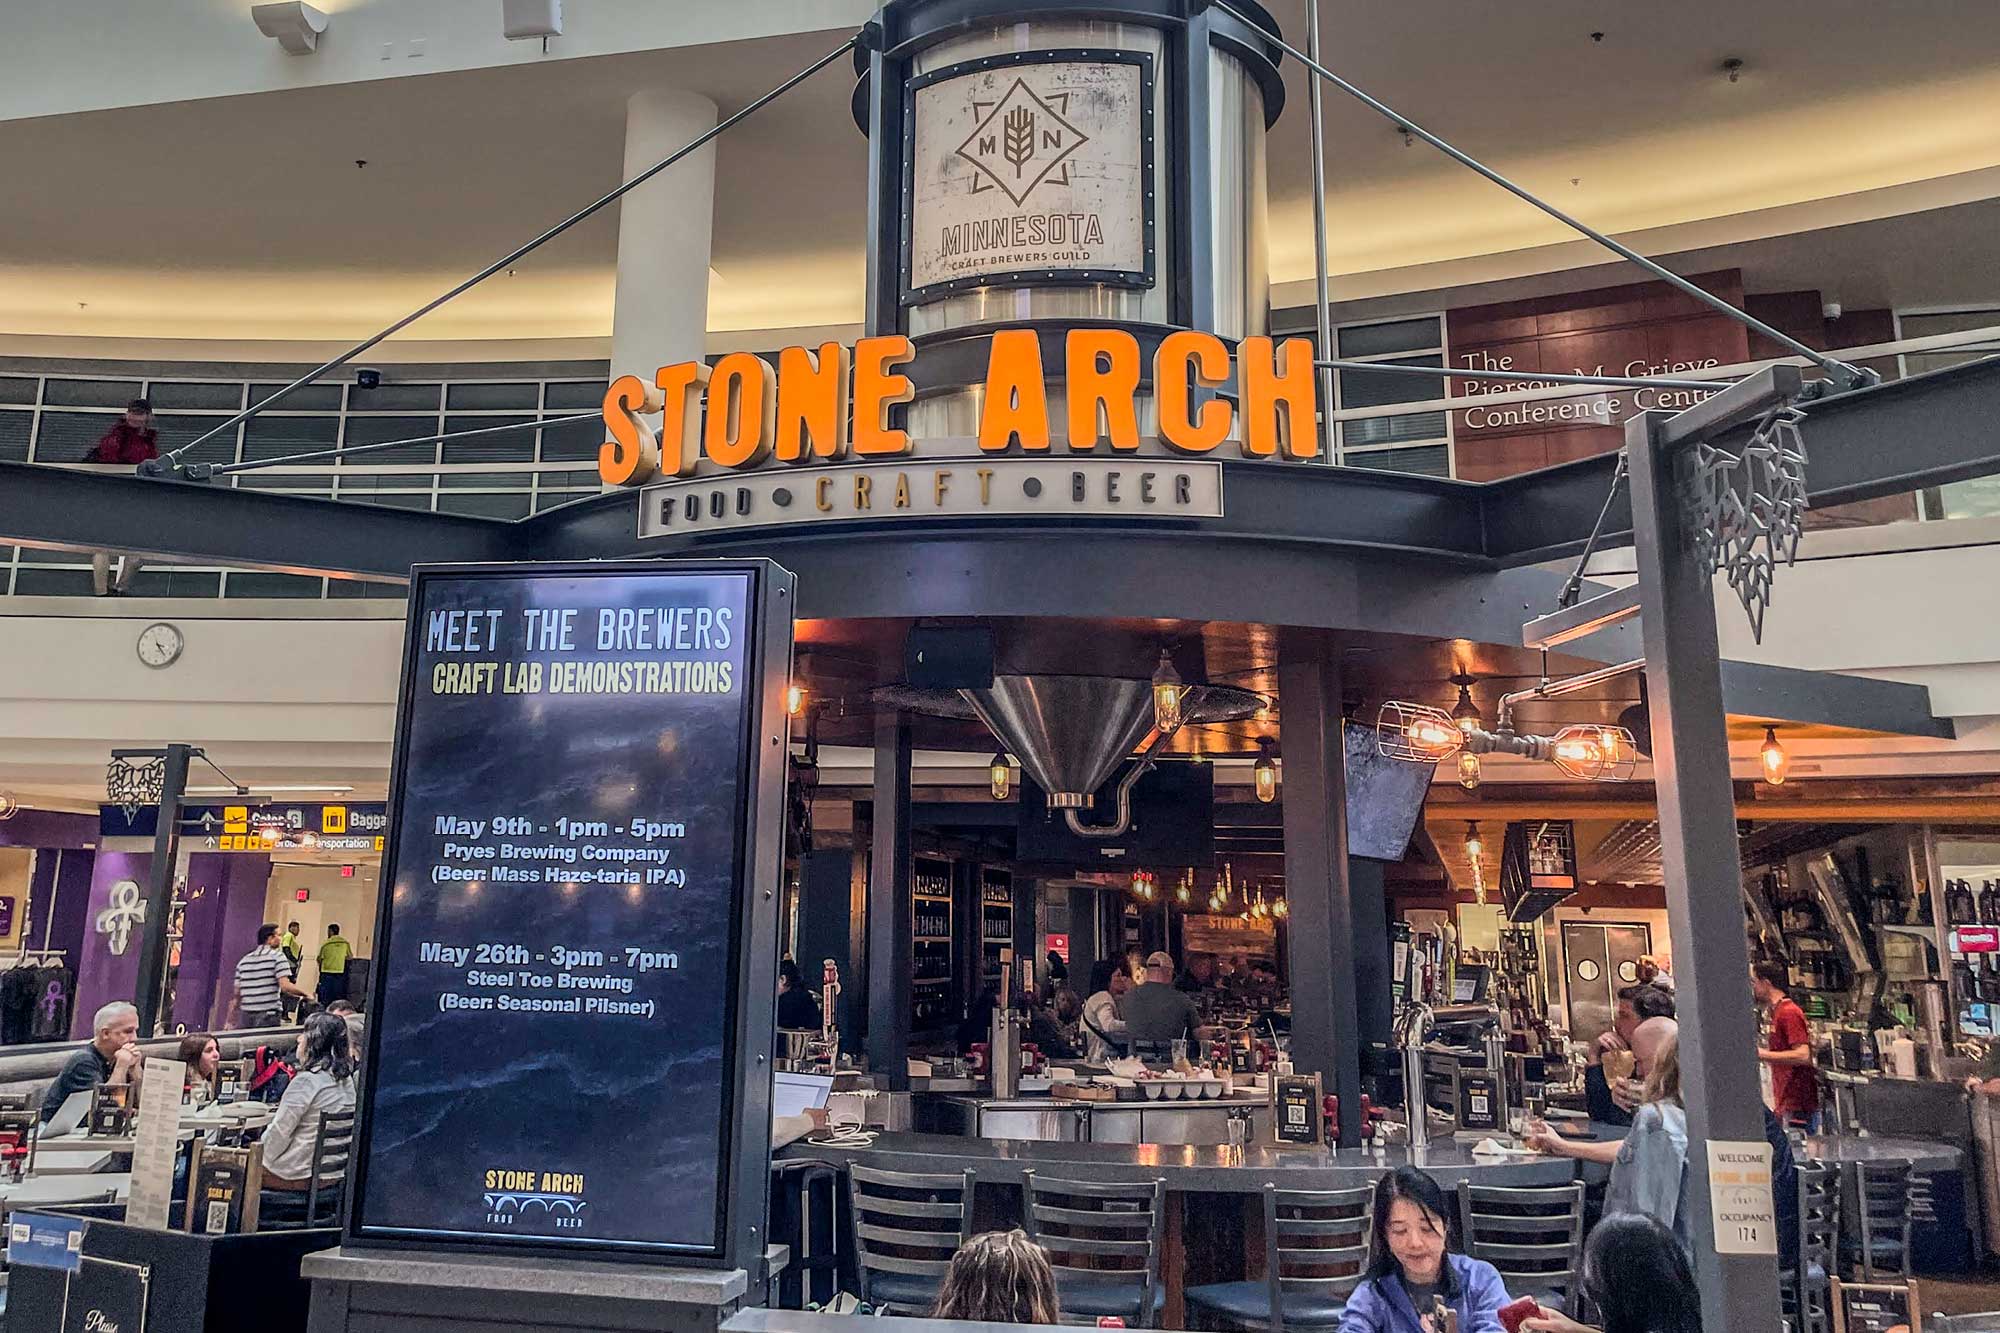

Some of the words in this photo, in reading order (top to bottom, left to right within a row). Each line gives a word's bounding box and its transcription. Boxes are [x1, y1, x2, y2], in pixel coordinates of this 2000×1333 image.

[979, 135, 996, 156] M
[1043, 130, 1061, 149] N
[941, 214, 1104, 258] MINNESOTA
[952, 257, 986, 271] CRAFT
[991, 252, 1047, 264] BREWERS
[1053, 251, 1090, 261] GUILD
[1461, 350, 1514, 372] The
[1624, 358, 1719, 379] Grieve
[599, 336, 914, 486] STONE
[979, 329, 1318, 458] ARCH
[1465, 397, 1621, 429] Conference
[661, 487, 751, 526] FOOD
[816, 467, 994, 512] CRAFT
[1072, 471, 1192, 505] BEER
[426, 609, 503, 652] MEET
[524, 609, 578, 651] THE
[597, 607, 732, 650] BREWERS
[432, 662, 498, 694] CRAFT
[503, 662, 542, 693] LAB
[549, 661, 732, 694] DEMONSTRATIONS
[434, 816, 486, 840] May
[492, 817, 532, 835] 9th
[555, 817, 607, 840] 1pm
[630, 818, 685, 841] 5pm
[443, 843, 495, 861] Pryes
[500, 844, 576, 863] Brewing
[581, 845, 670, 864] Company
[431, 865, 486, 883] (Beer:
[491, 866, 540, 882] Mass
[545, 867, 641, 884] Haze-taria
[646, 869, 686, 888] IPA)
[419, 942, 470, 967] May
[474, 944, 529, 964] 26th
[550, 945, 602, 970] 3pm
[625, 948, 679, 972] 7pm
[467, 970, 514, 987] Steel
[519, 972, 553, 988] Toe
[557, 973, 633, 994] Brewing
[439, 993, 493, 1012] (Beer:
[497, 995, 580, 1013] Seasonal
[585, 997, 655, 1018] Pilsner)
[1717, 1152, 1766, 1164] WELCOME
[485, 1169, 535, 1191] STONE
[541, 1172, 584, 1193] ARCH
[486, 1213, 513, 1224] FOOD
[556, 1217, 583, 1228] BEER
[1738, 1226, 1757, 1242] 174
